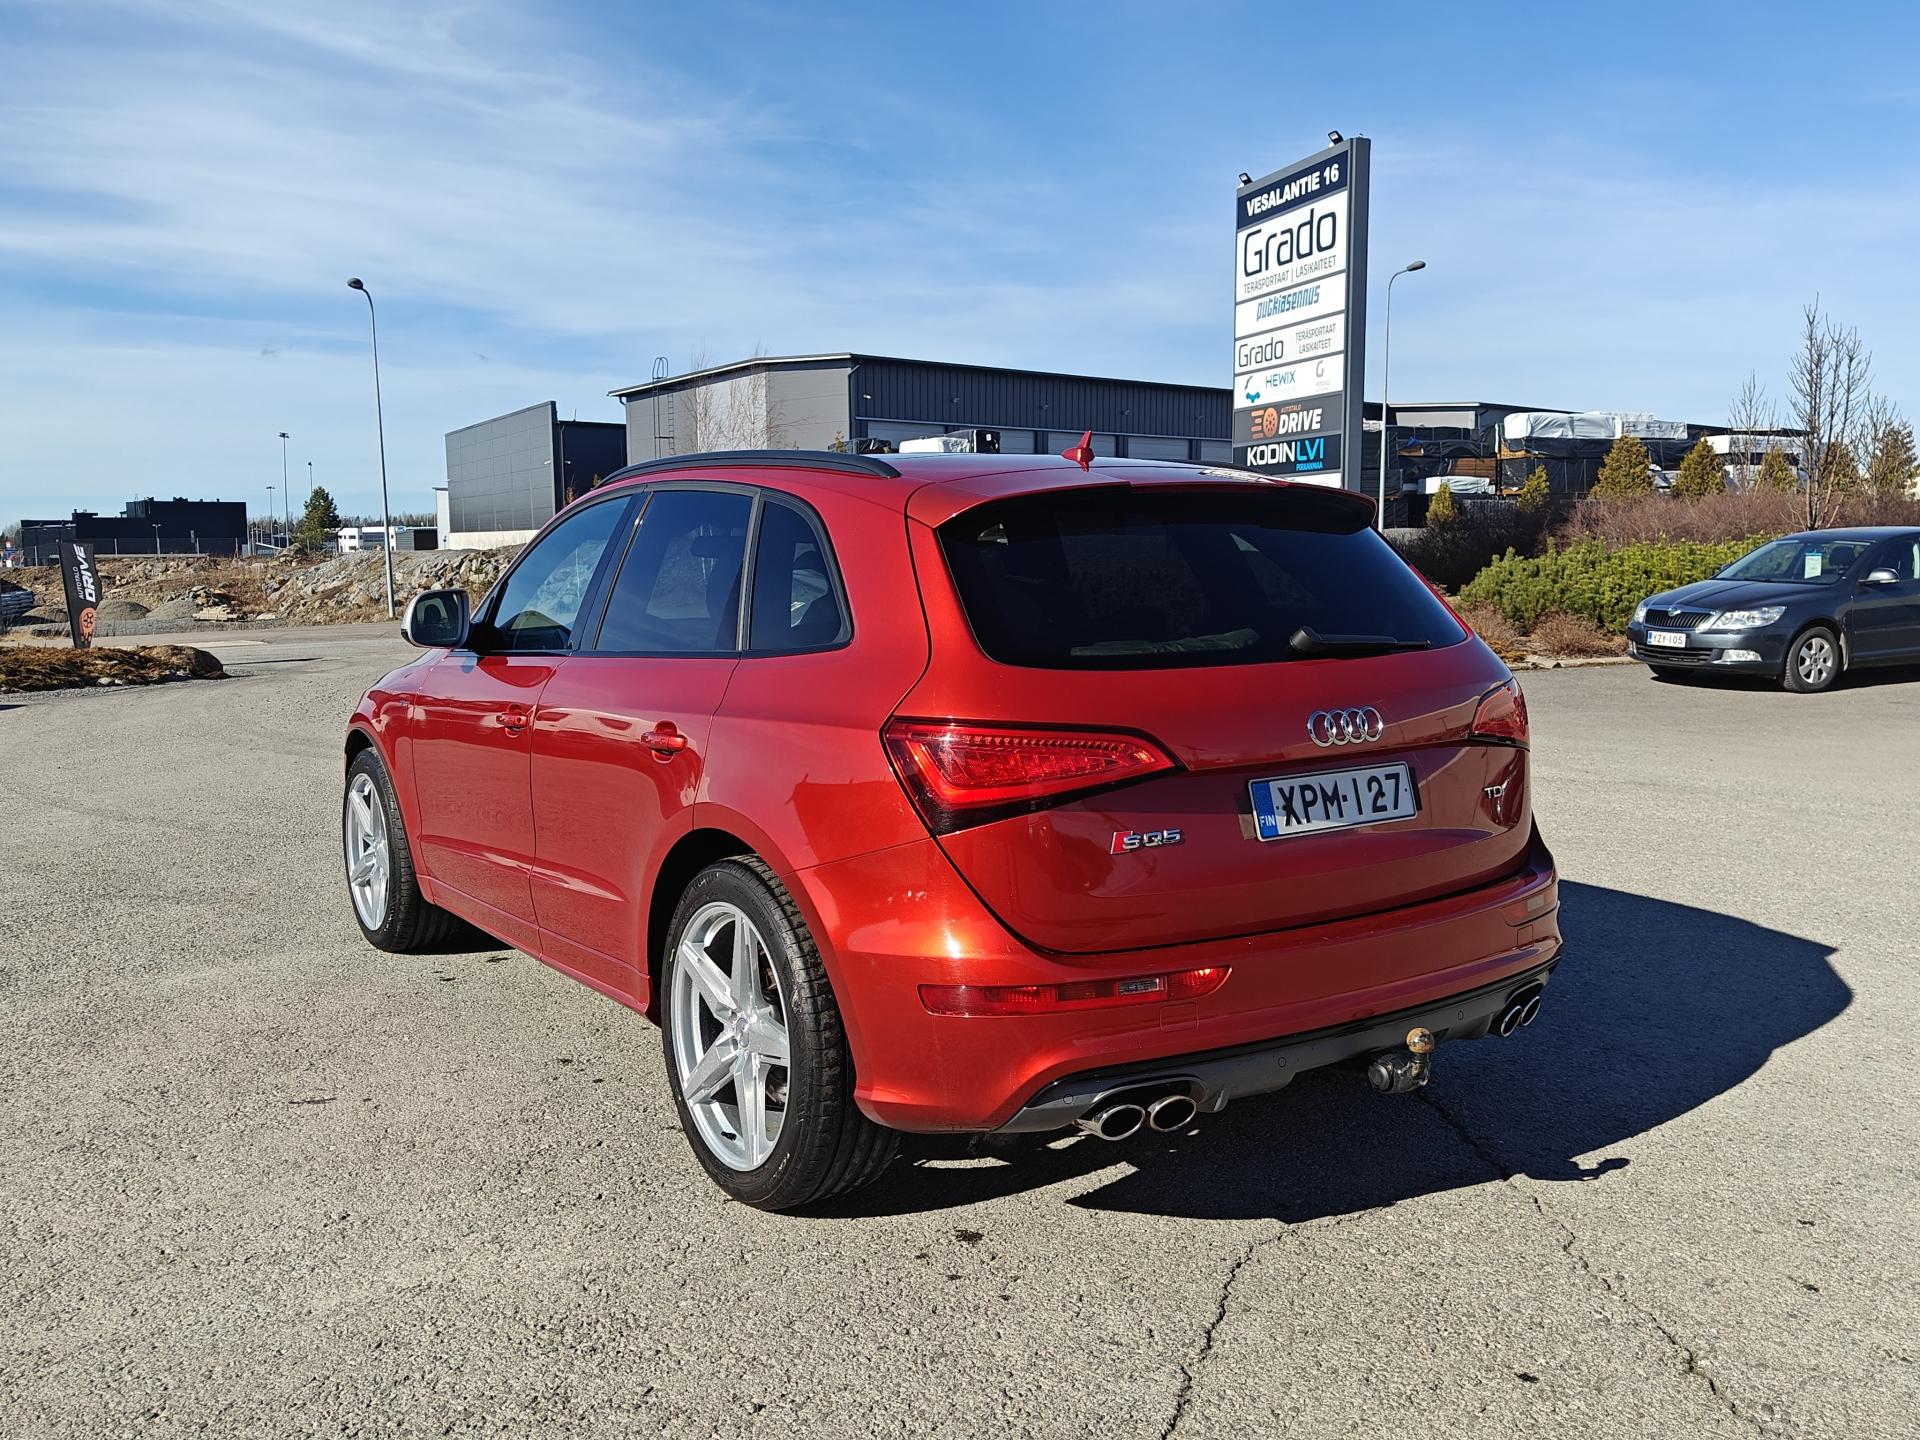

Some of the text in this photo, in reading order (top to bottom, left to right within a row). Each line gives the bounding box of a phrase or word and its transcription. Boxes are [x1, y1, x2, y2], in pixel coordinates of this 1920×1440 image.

[1246, 164, 1339, 216] VESALANTIE 16
[1244, 208, 1337, 277] Grado
[1296, 255, 1337, 278] LASIKAITEET
[1238, 337, 1284, 368] Grado
[1299, 338, 1331, 354] LASIKAITEET
[1265, 370, 1296, 389] HEWIX
[1278, 408, 1322, 435] DRIVE
[73, 543, 96, 603] DRIVE
[1276, 773, 1402, 827] XPM-127
[1260, 814, 1276, 827] FIN
[1121, 828, 1181, 850] SQ5
